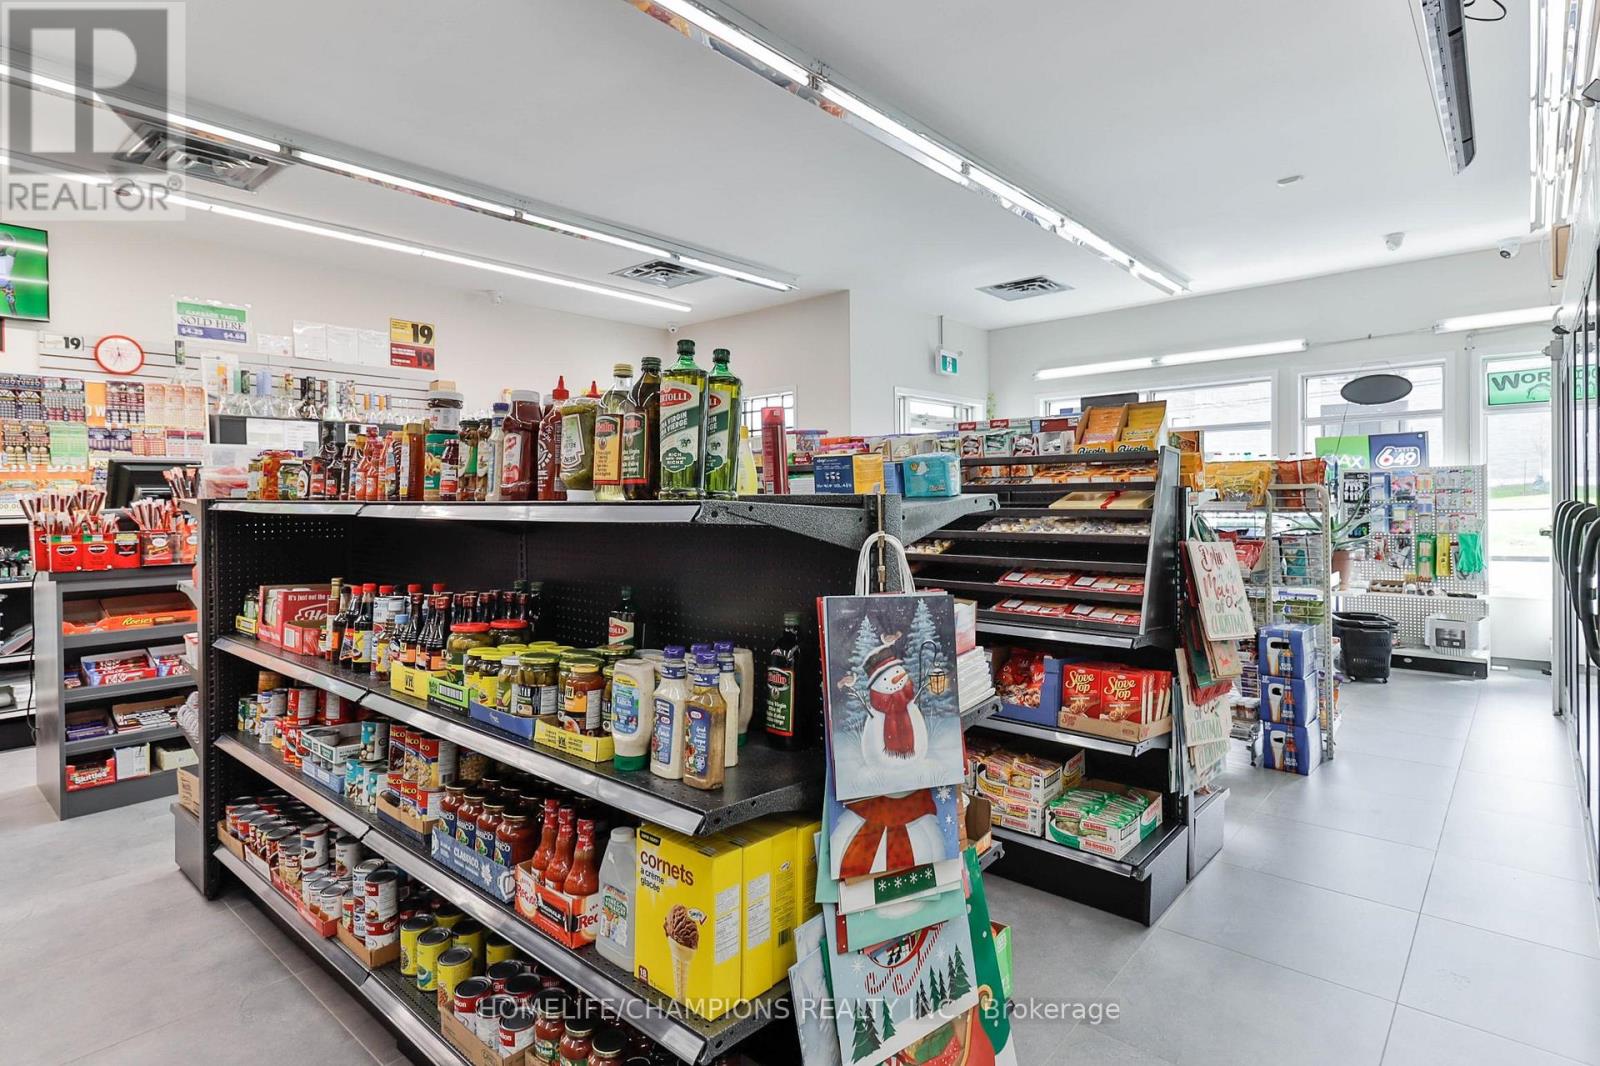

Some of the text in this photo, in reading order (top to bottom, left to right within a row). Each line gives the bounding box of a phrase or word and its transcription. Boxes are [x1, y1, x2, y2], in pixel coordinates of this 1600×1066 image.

[180, 315, 243, 330] SOLD HERE
[411, 323, 433, 344] 19
[63, 336, 81, 350] 19
[667, 411, 687, 426] VIRGIN
[667, 418, 688, 433] VIERGE
[1118, 445, 1148, 453] Ricola
[1065, 669, 1095, 687] Stove
[1104, 676, 1136, 695] Stove
[1076, 682, 1091, 694] Top
[1114, 689, 1131, 701] Top
[640, 850, 694, 886] cornets
[645, 868, 665, 885] crème
[640, 876, 661, 893] glacée
